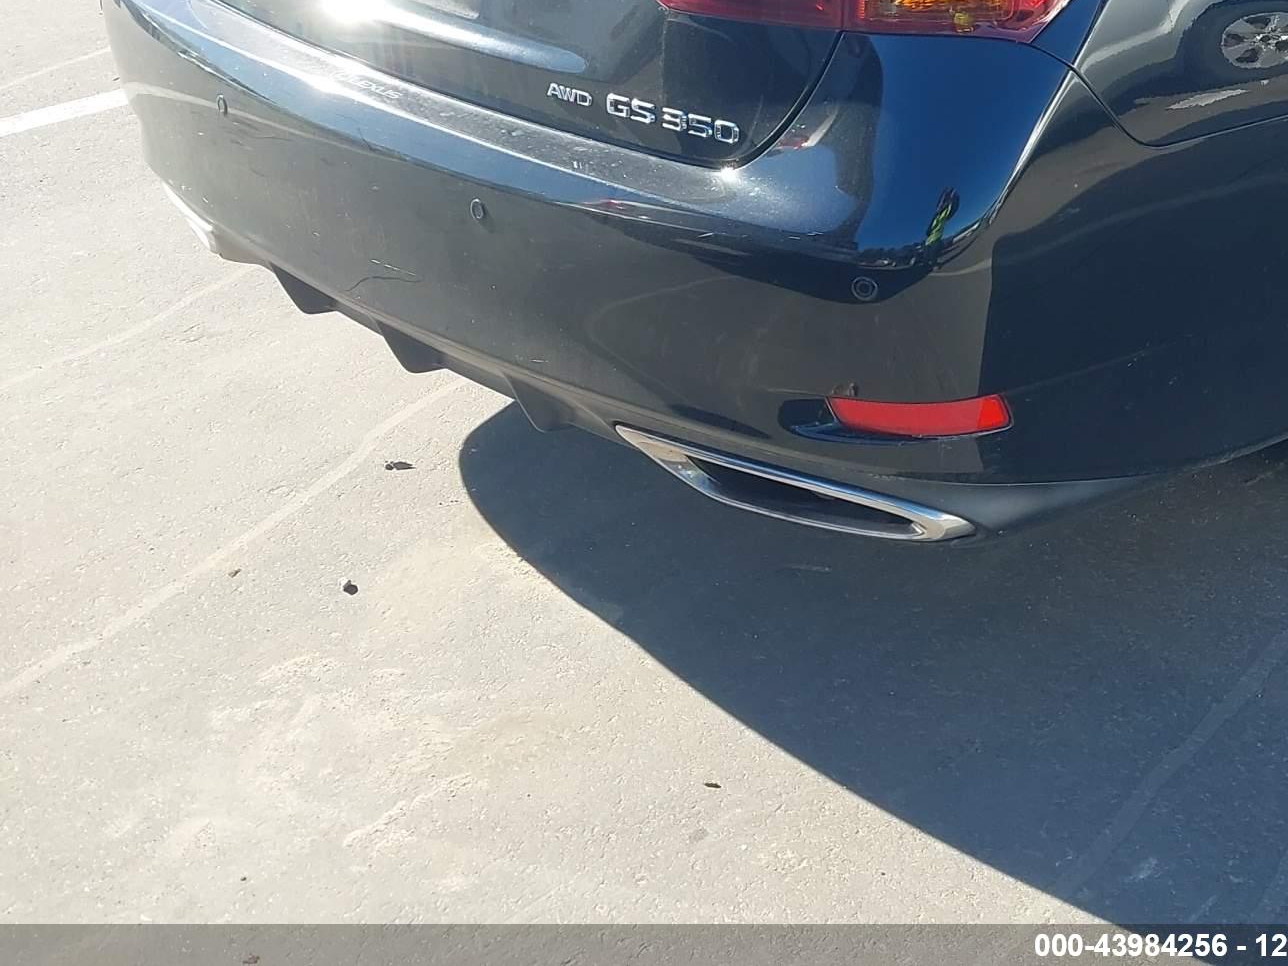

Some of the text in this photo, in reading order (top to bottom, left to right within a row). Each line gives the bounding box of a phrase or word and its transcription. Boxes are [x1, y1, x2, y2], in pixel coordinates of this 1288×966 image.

[546, 82, 593, 107] AWD
[606, 92, 741, 145] GS 350
